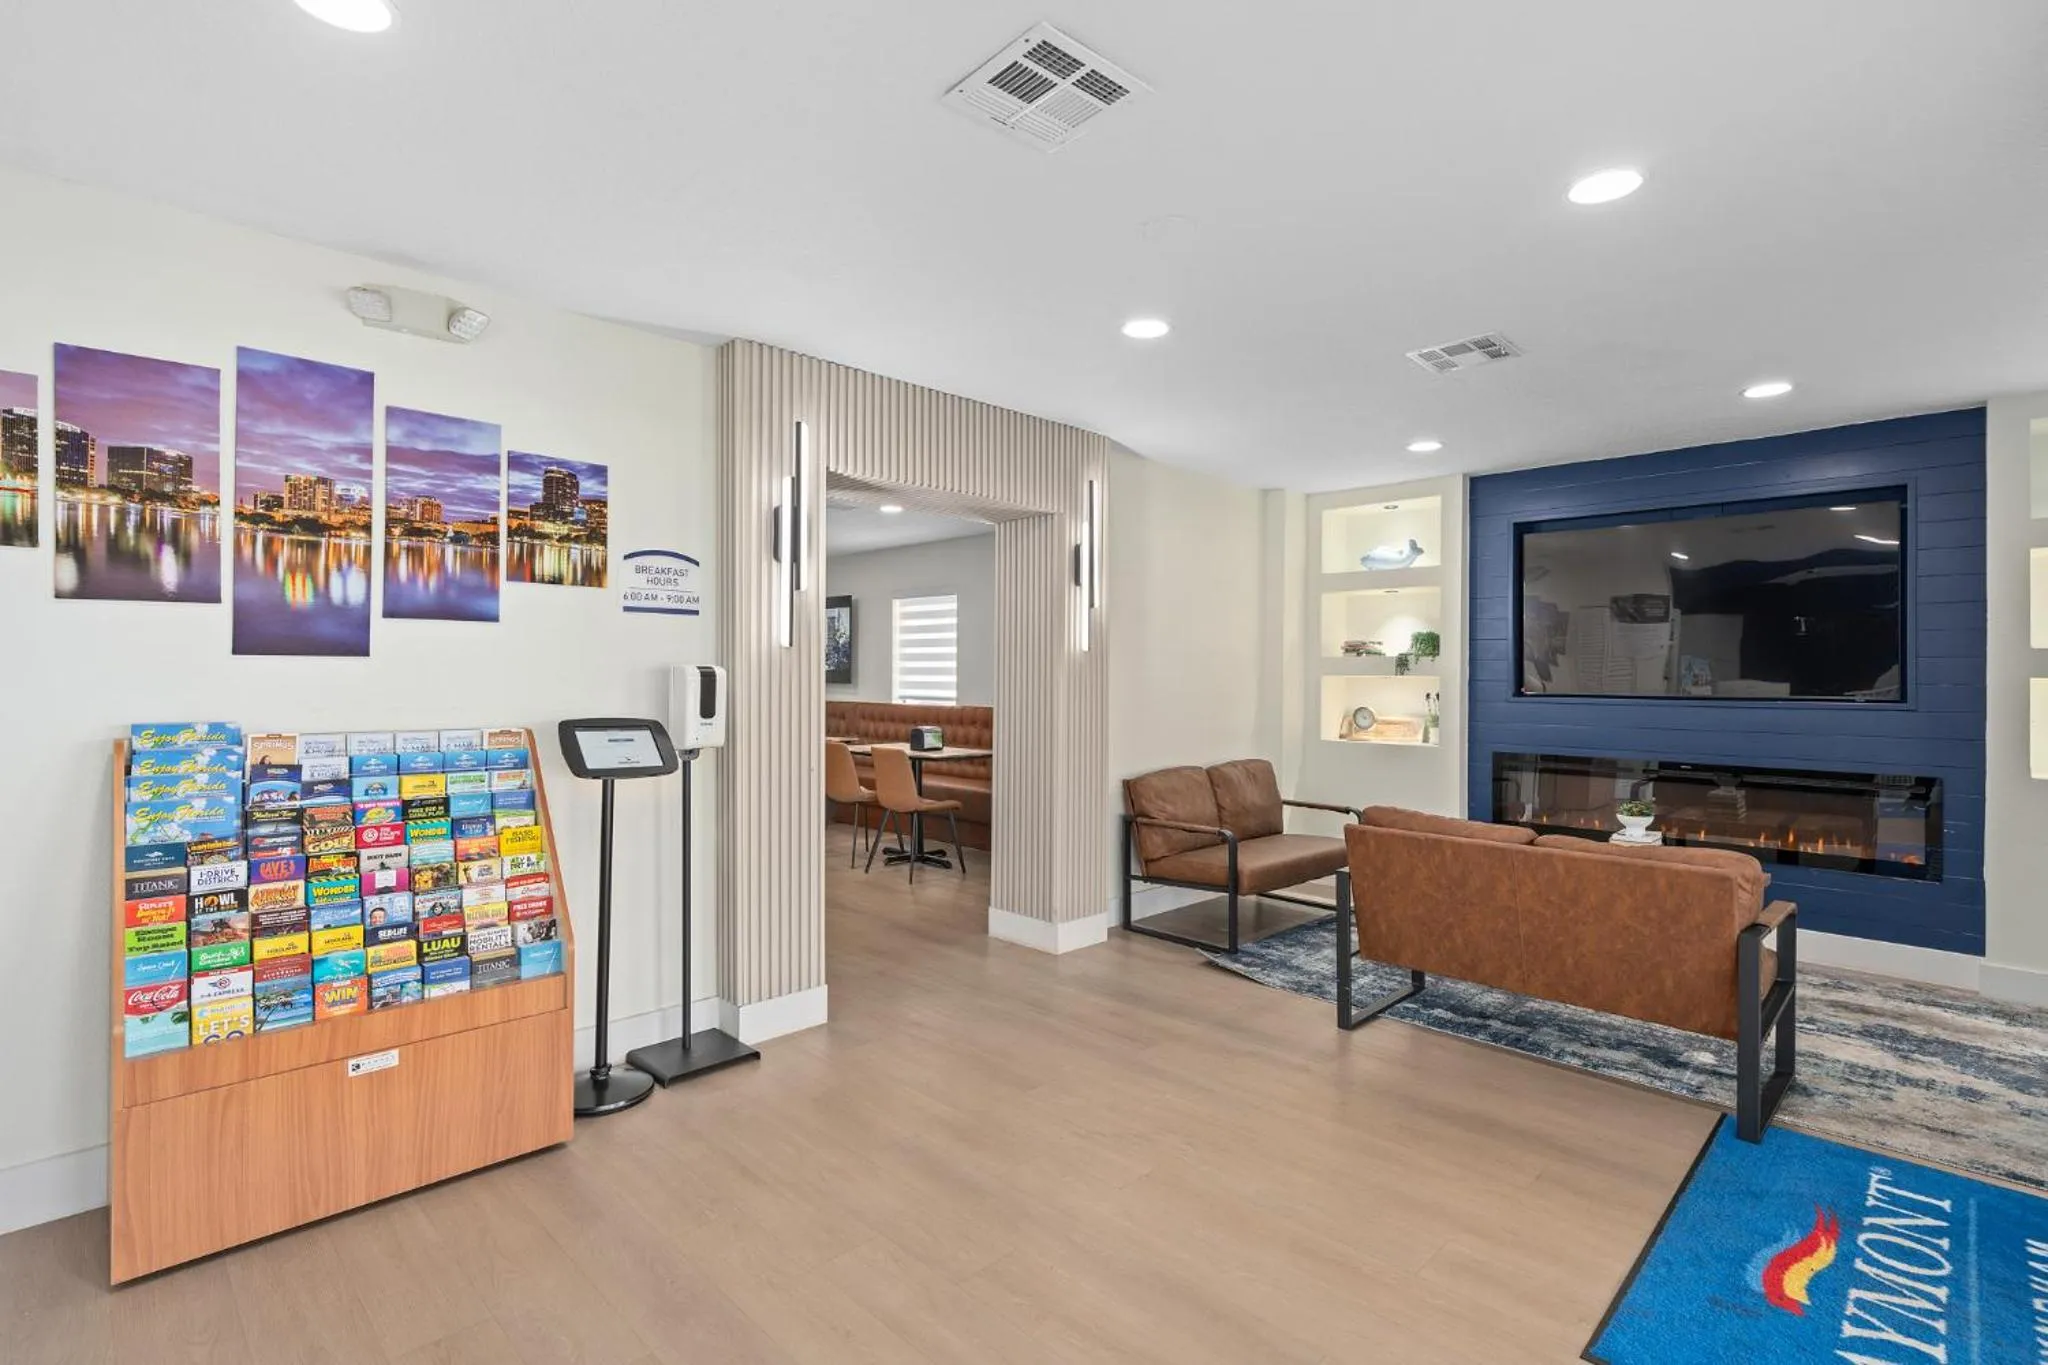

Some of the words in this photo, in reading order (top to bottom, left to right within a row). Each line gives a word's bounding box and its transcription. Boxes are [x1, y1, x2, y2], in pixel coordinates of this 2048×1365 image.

[635, 564, 689, 577] BREAKFAST
[646, 576, 680, 587] HOURS
[138, 729, 179, 748] Enjoy
[179, 728, 226, 744] Florida
[135, 780, 177, 798] Enjoy
[177, 779, 227, 794] Florida
[133, 807, 175, 827] Enjoy
[174, 805, 225, 821] Florida
[197, 874, 240, 886] DISTRICT
[200, 867, 237, 879] I-DRIVE
[132, 880, 179, 894] TITANIC
[312, 885, 356, 897] WONDER
[194, 892, 239, 910] HOWL
[423, 936, 461, 953] LUAU
[128, 983, 183, 1006] Coca-Cola
[324, 985, 359, 1003] WIN
[198, 1014, 251, 1036] LET'S
